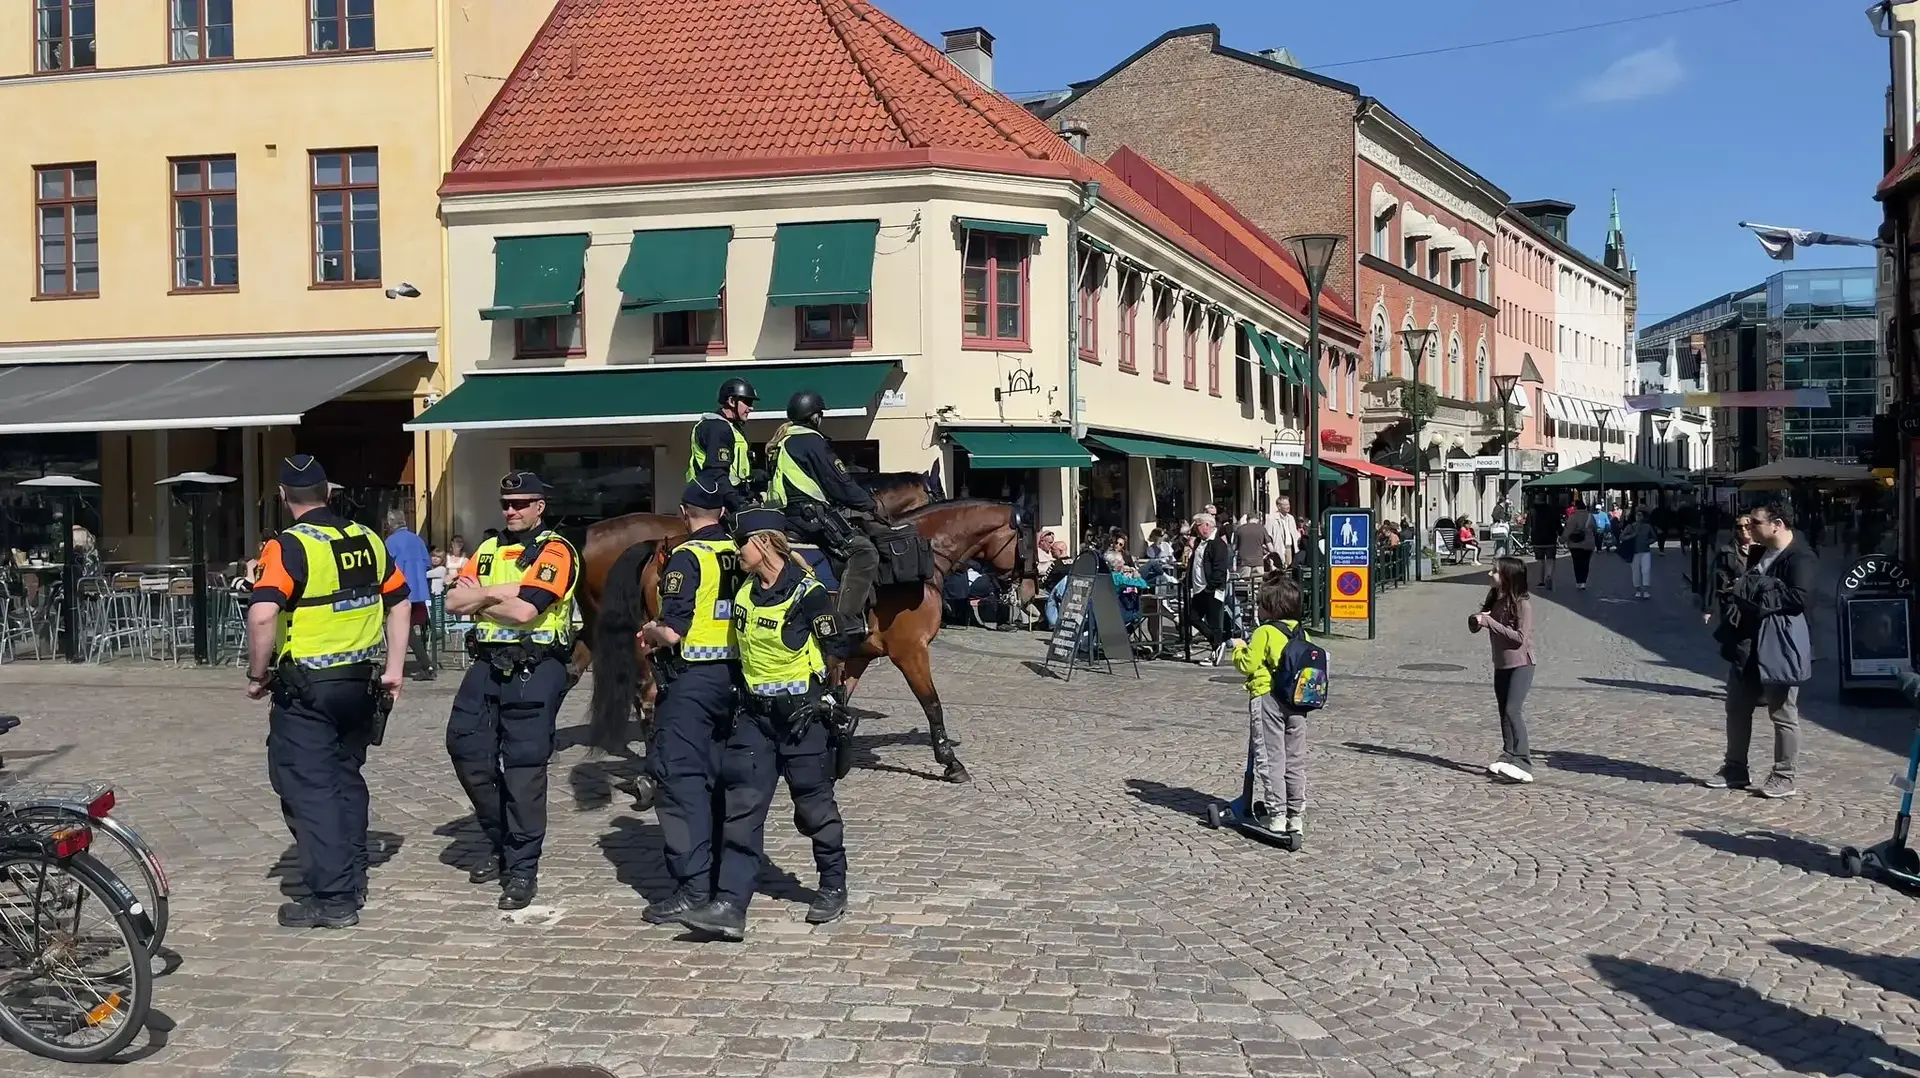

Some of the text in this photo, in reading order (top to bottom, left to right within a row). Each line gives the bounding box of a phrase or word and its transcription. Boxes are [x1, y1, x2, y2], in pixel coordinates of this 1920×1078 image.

[340, 548, 372, 570] D71
[480, 554, 493, 564] D71
[1845, 561, 1910, 589] GUSTUS
[757, 618, 778, 628] POLIS
[814, 615, 832, 627] POLIS
